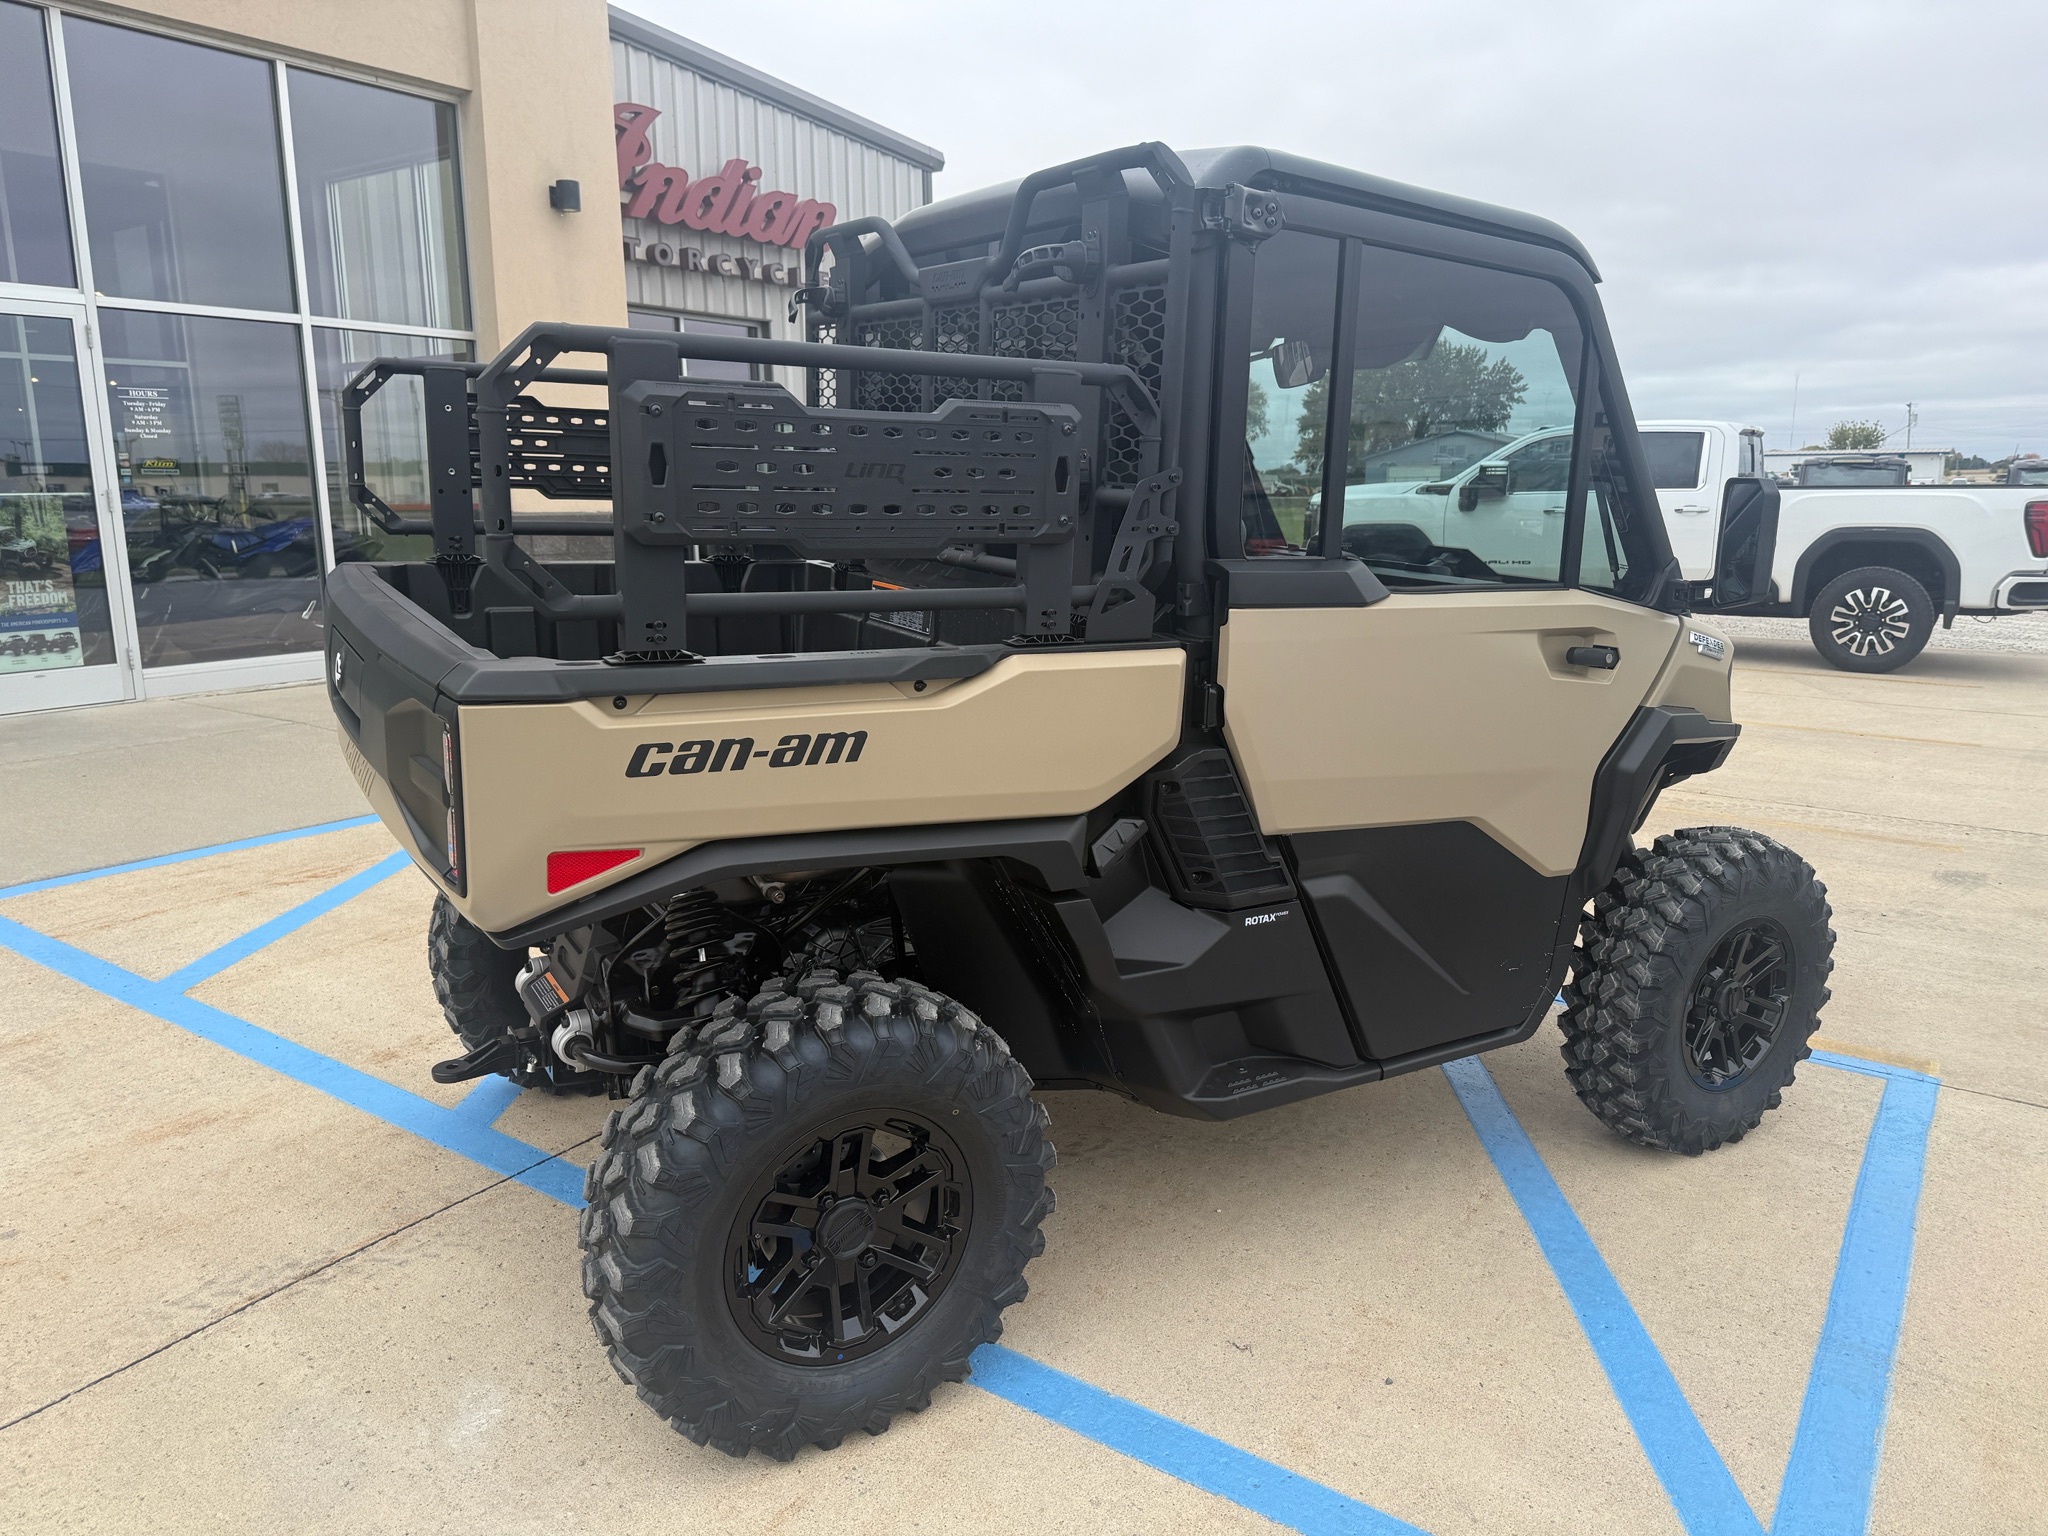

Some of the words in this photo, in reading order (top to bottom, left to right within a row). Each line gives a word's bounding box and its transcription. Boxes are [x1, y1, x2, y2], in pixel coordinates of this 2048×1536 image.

[613, 102, 837, 252] Indian
[6, 579, 54, 594] THAT'S
[8, 591, 69, 608] FREEDOM
[1693, 633, 1724, 650] DEFENDER
[625, 730, 868, 778] can-am
[1245, 913, 1276, 926] ROTAX
